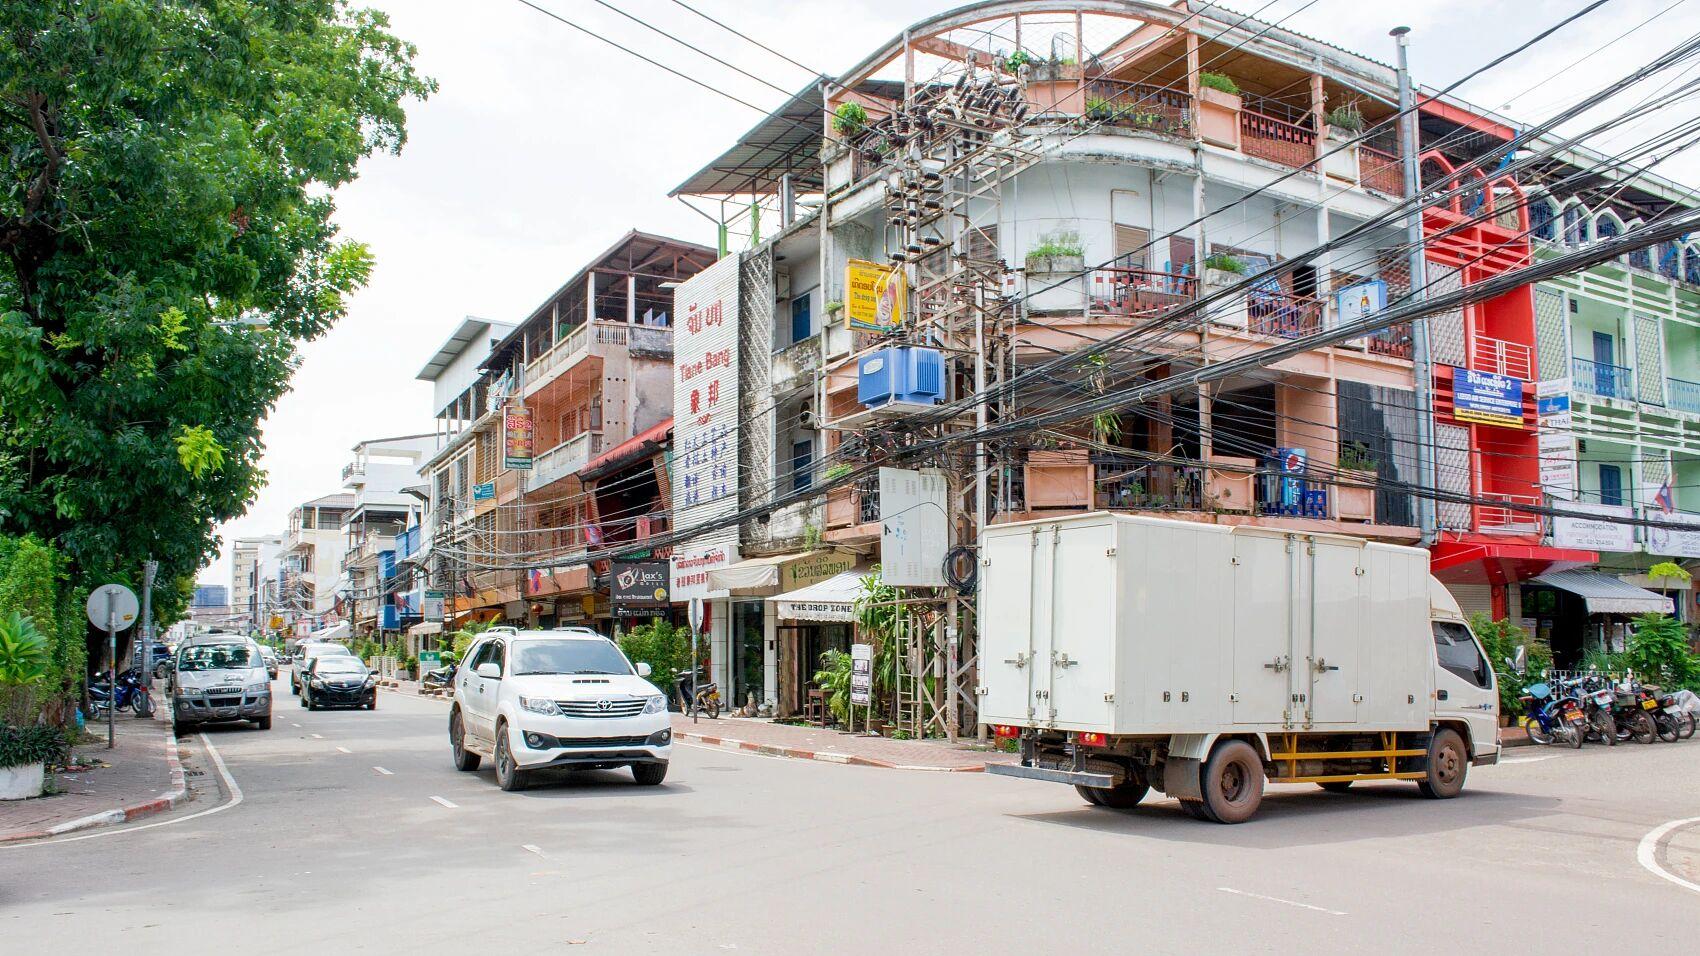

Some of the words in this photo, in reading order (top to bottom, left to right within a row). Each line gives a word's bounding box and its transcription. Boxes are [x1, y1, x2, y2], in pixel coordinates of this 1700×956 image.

[705, 348, 730, 369] Bang
[808, 604, 828, 612] DROP
[830, 605, 852, 613] ZONE
